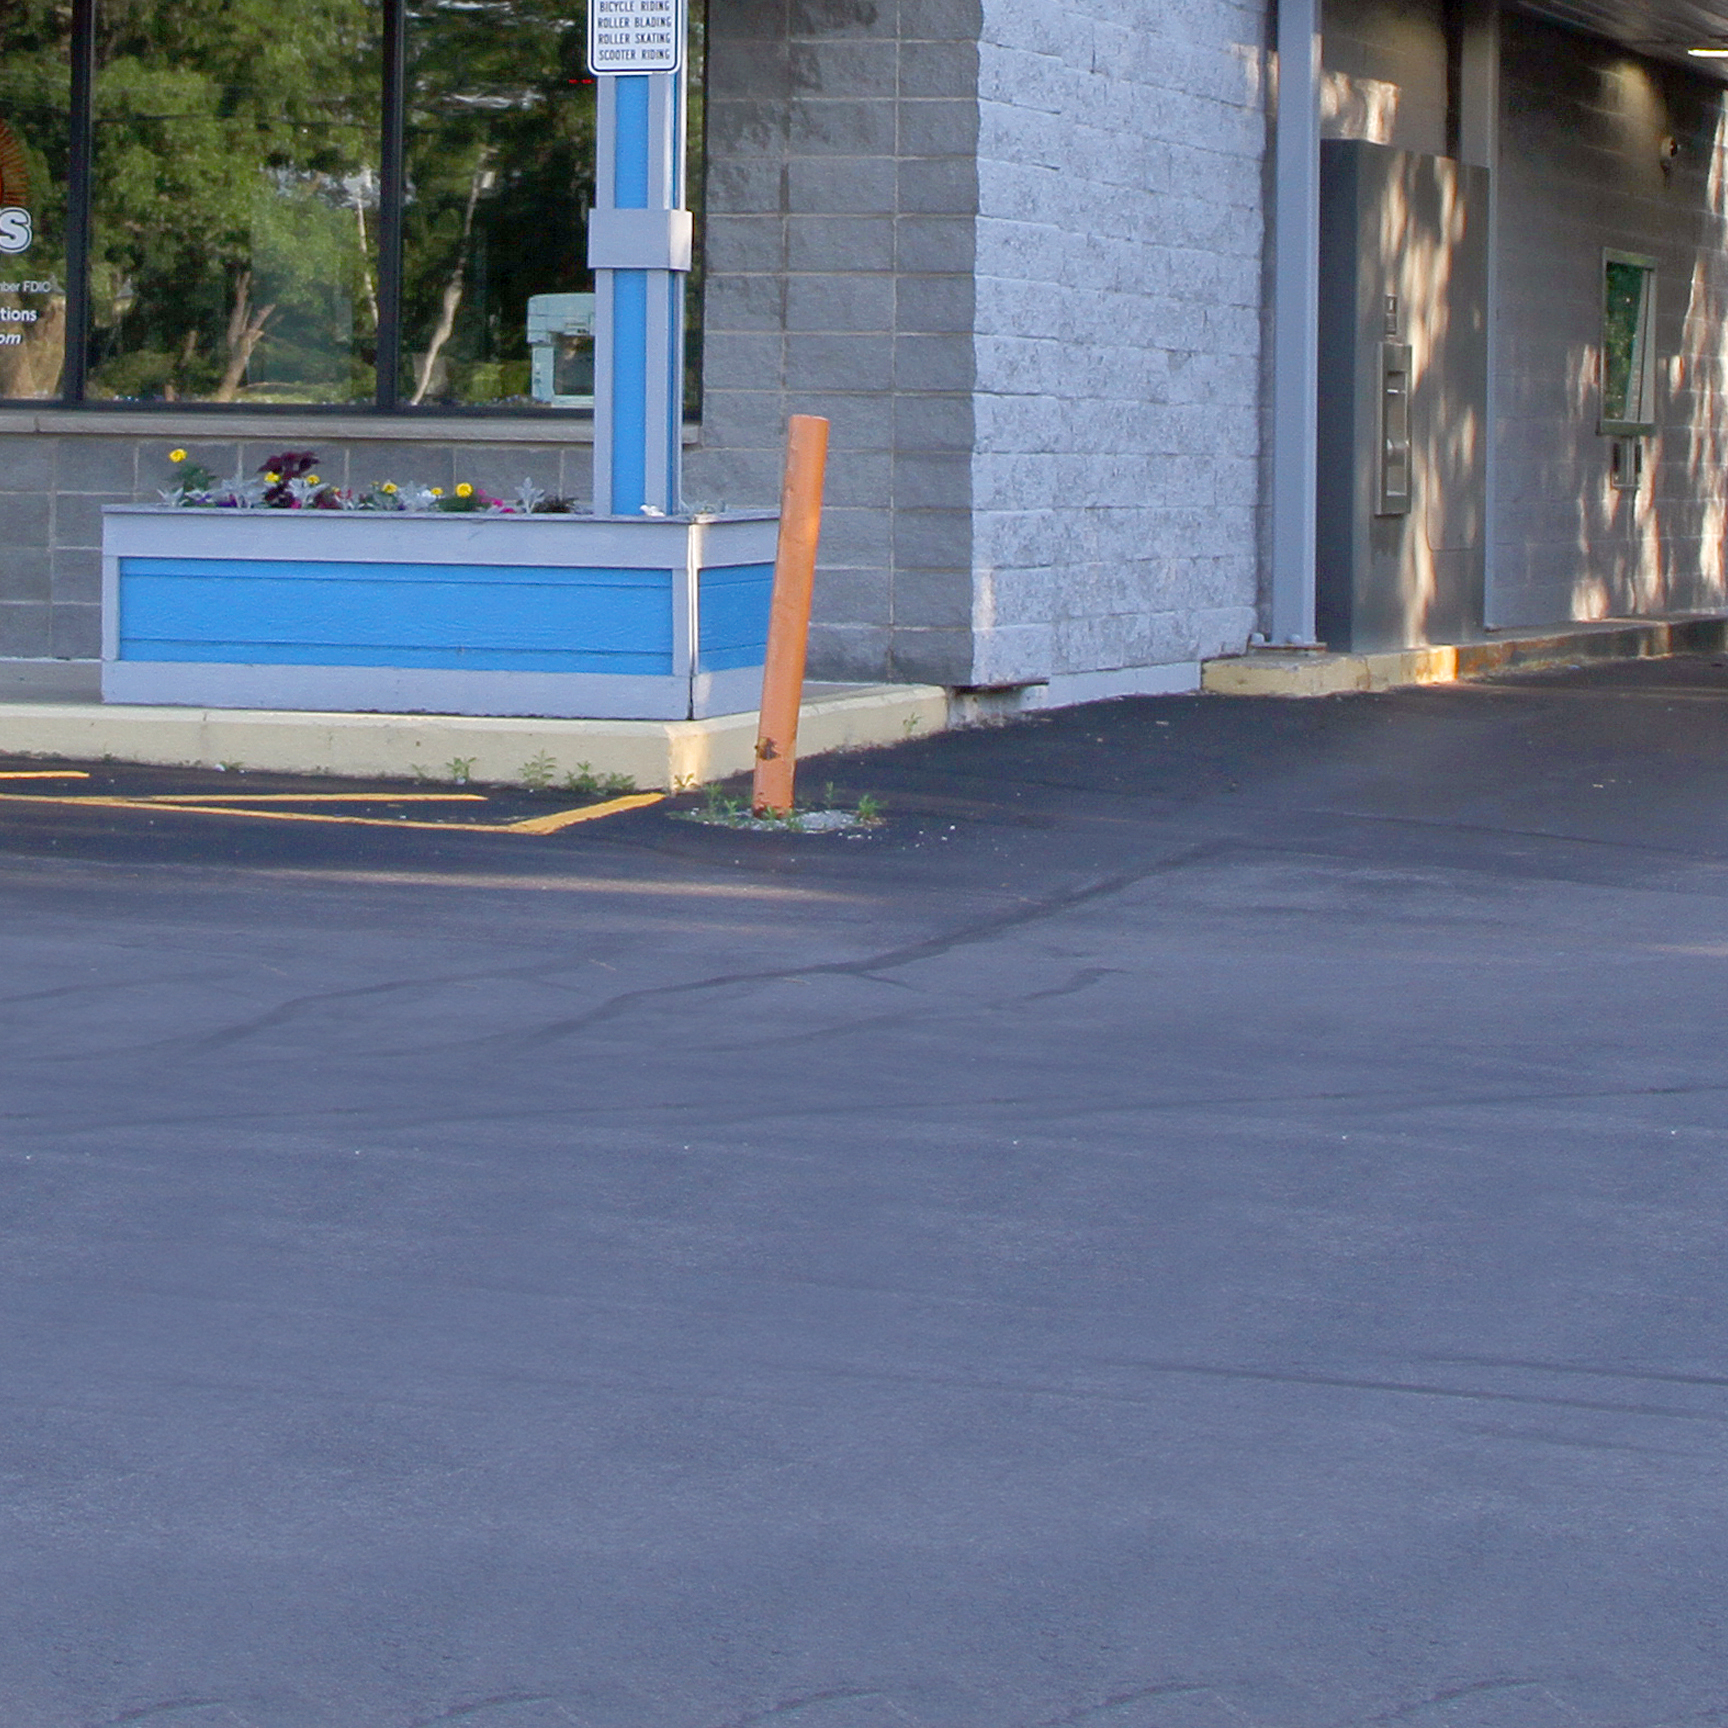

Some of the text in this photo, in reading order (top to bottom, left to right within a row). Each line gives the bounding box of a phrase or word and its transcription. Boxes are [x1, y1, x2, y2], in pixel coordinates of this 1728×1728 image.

[599, 0, 671, 13] BICYCLE RIDING
[597, 16, 673, 29] ROLLER BLADING
[597, 32, 671, 45] ROLLER SKATING
[598, 48, 671, 62] SCOOTER RIDING
[22, 280, 52, 293] FDIC
